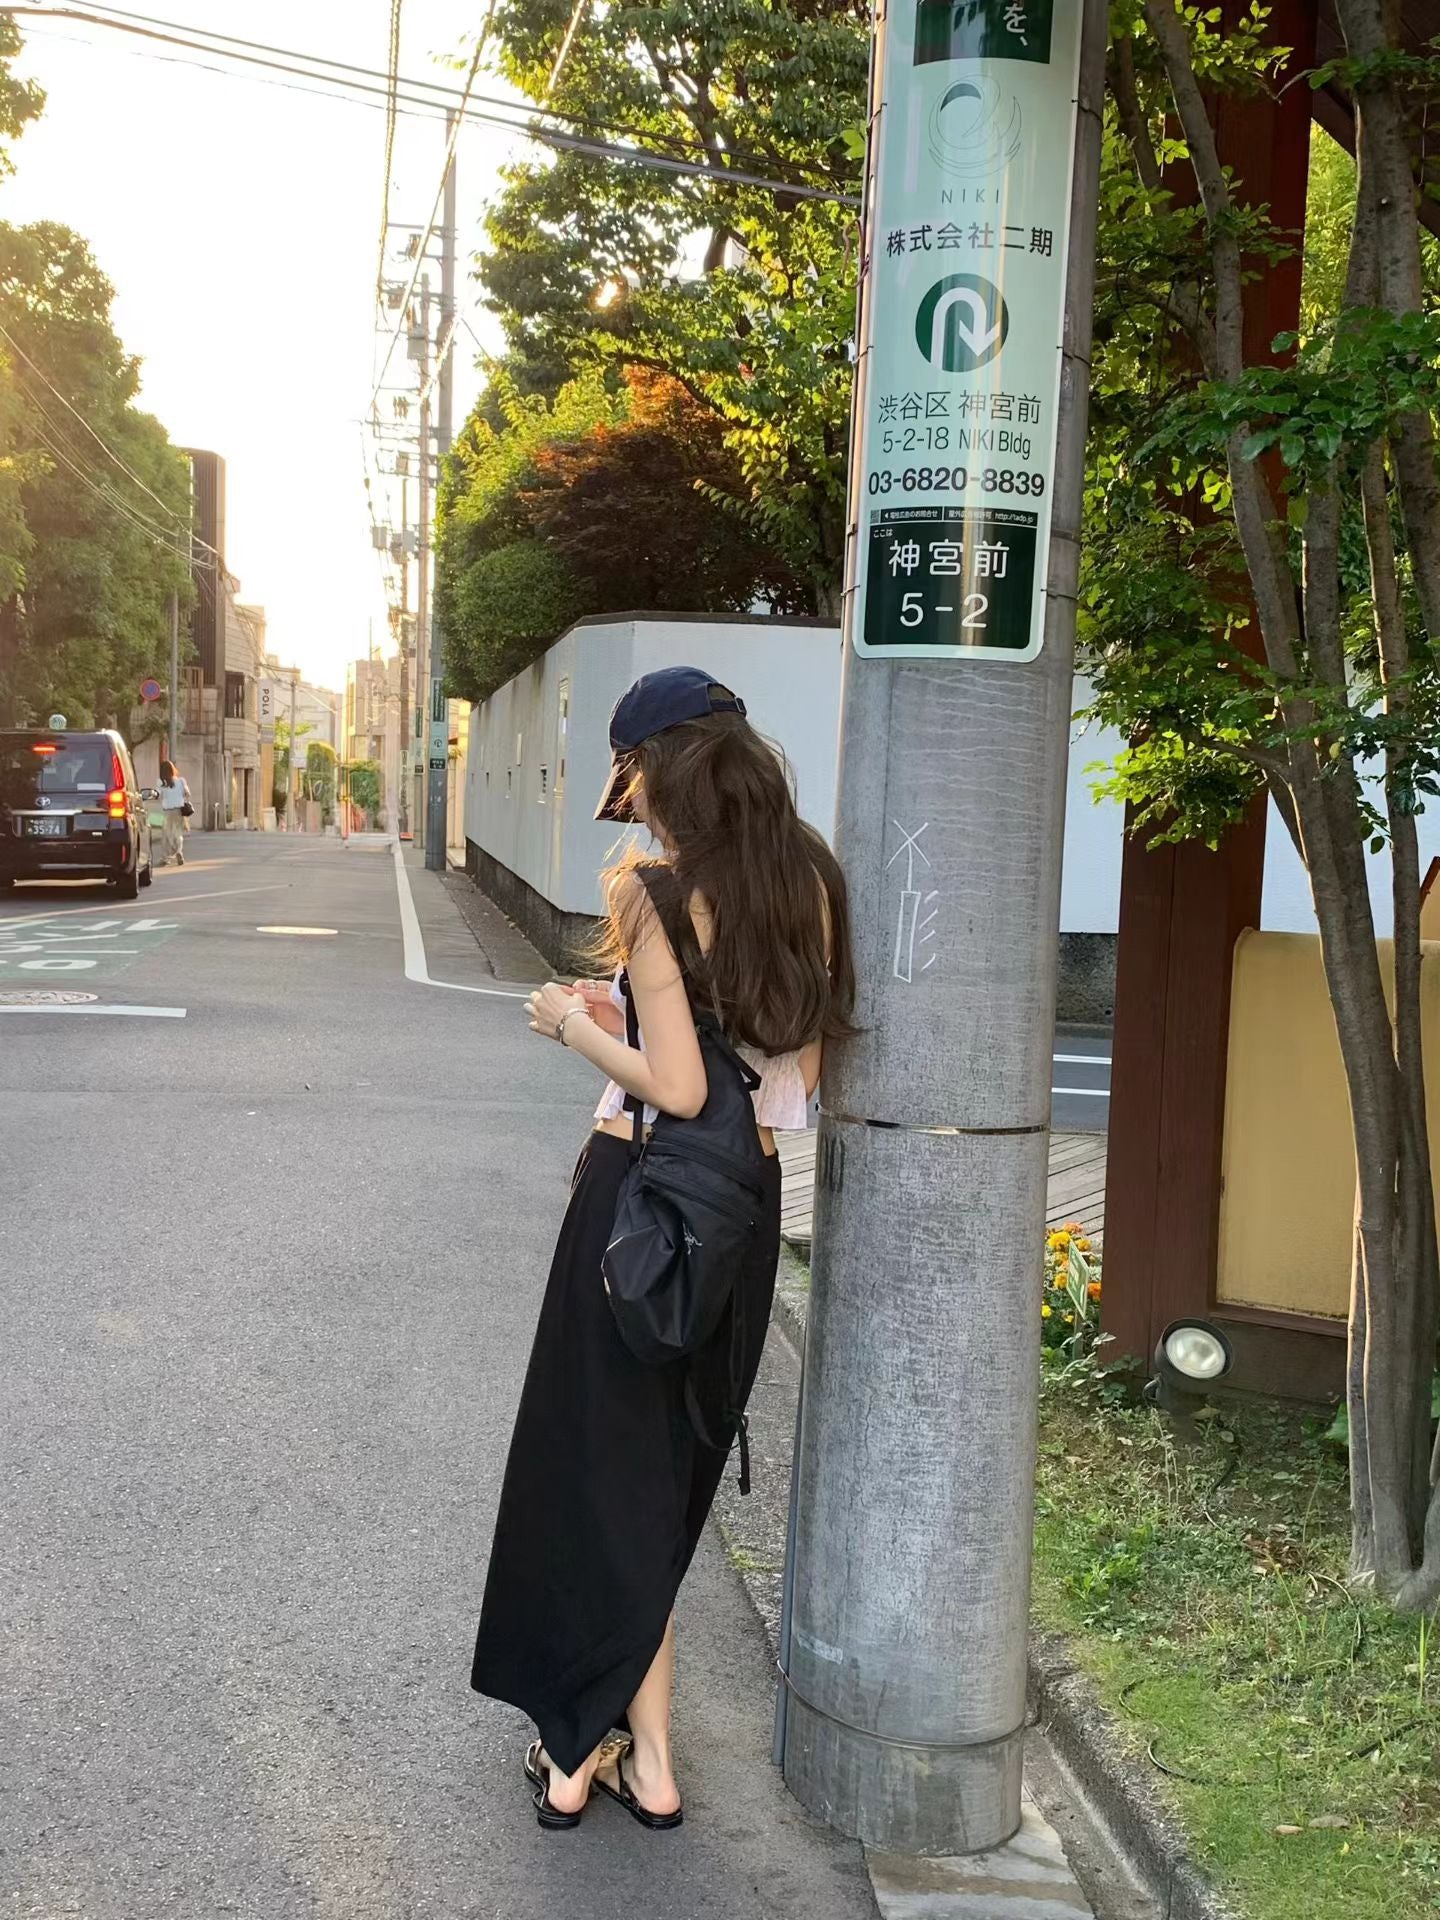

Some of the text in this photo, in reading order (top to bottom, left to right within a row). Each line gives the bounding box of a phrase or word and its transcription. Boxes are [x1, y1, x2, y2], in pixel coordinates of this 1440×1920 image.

[941, 188, 1000, 204] NIKI
[887, 222, 1054, 258] 株式会社二期
[878, 389, 1042, 425] 渋谷区 神宮前
[882, 426, 1031, 461] 5-2-18 NIKI Bldg
[868, 467, 1045, 498] 03-6820-8839
[873, 528, 893, 538] ここは
[888, 538, 1010, 578] 神宮前
[900, 592, 989, 628] 5-2
[262, 688, 270, 716] POLA
